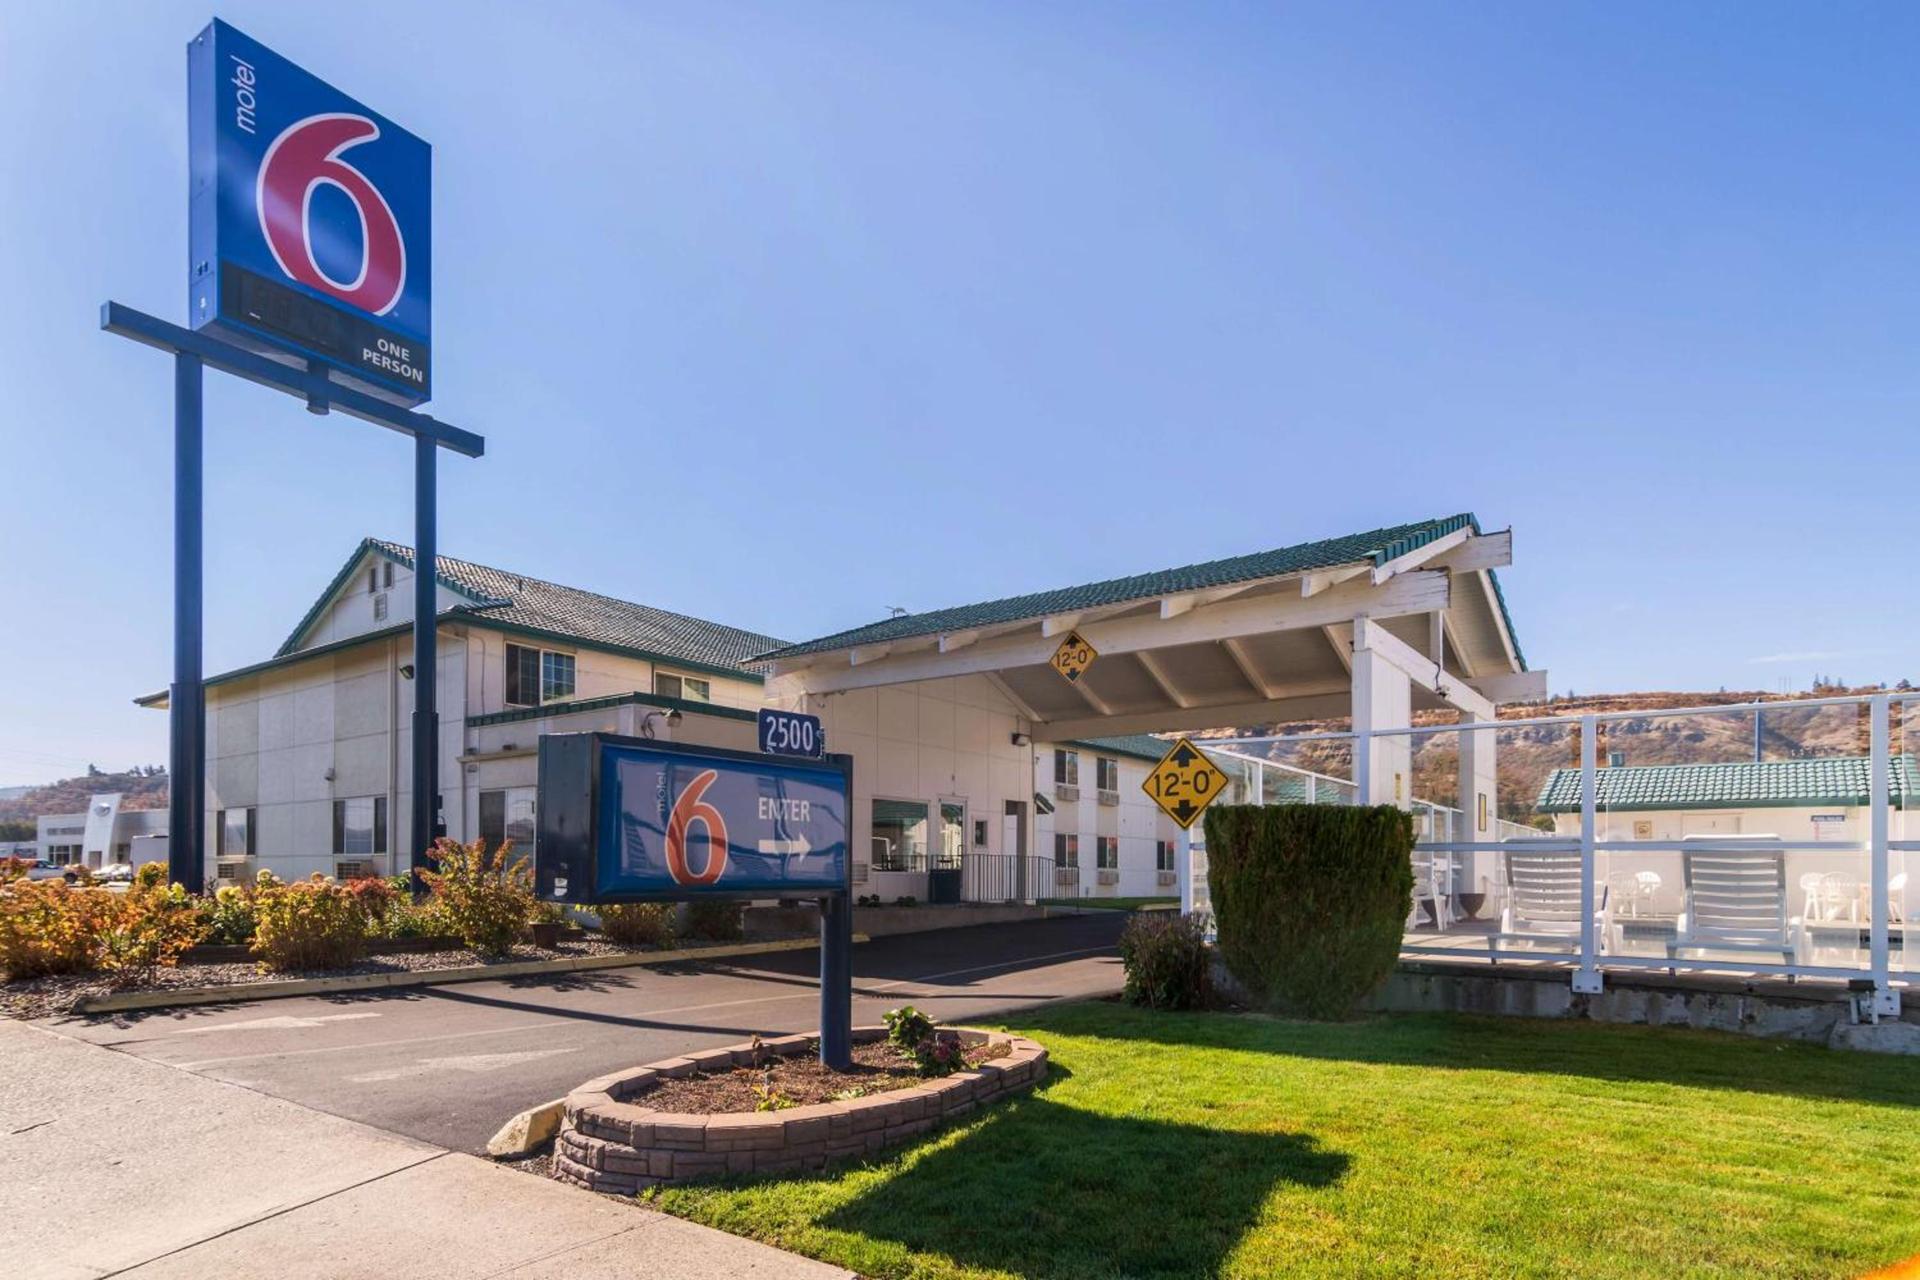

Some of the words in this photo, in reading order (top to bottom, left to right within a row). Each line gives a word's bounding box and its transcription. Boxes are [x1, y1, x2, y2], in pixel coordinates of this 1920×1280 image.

[230, 55, 256, 134] motel
[256, 112, 406, 317] 6
[362, 347, 423, 384] PERSON
[377, 338, 411, 362] ONE
[766, 716, 813, 751] 2500
[656, 772, 666, 812] motel
[758, 797, 810, 822] ENTER
[665, 769, 728, 885] 6
